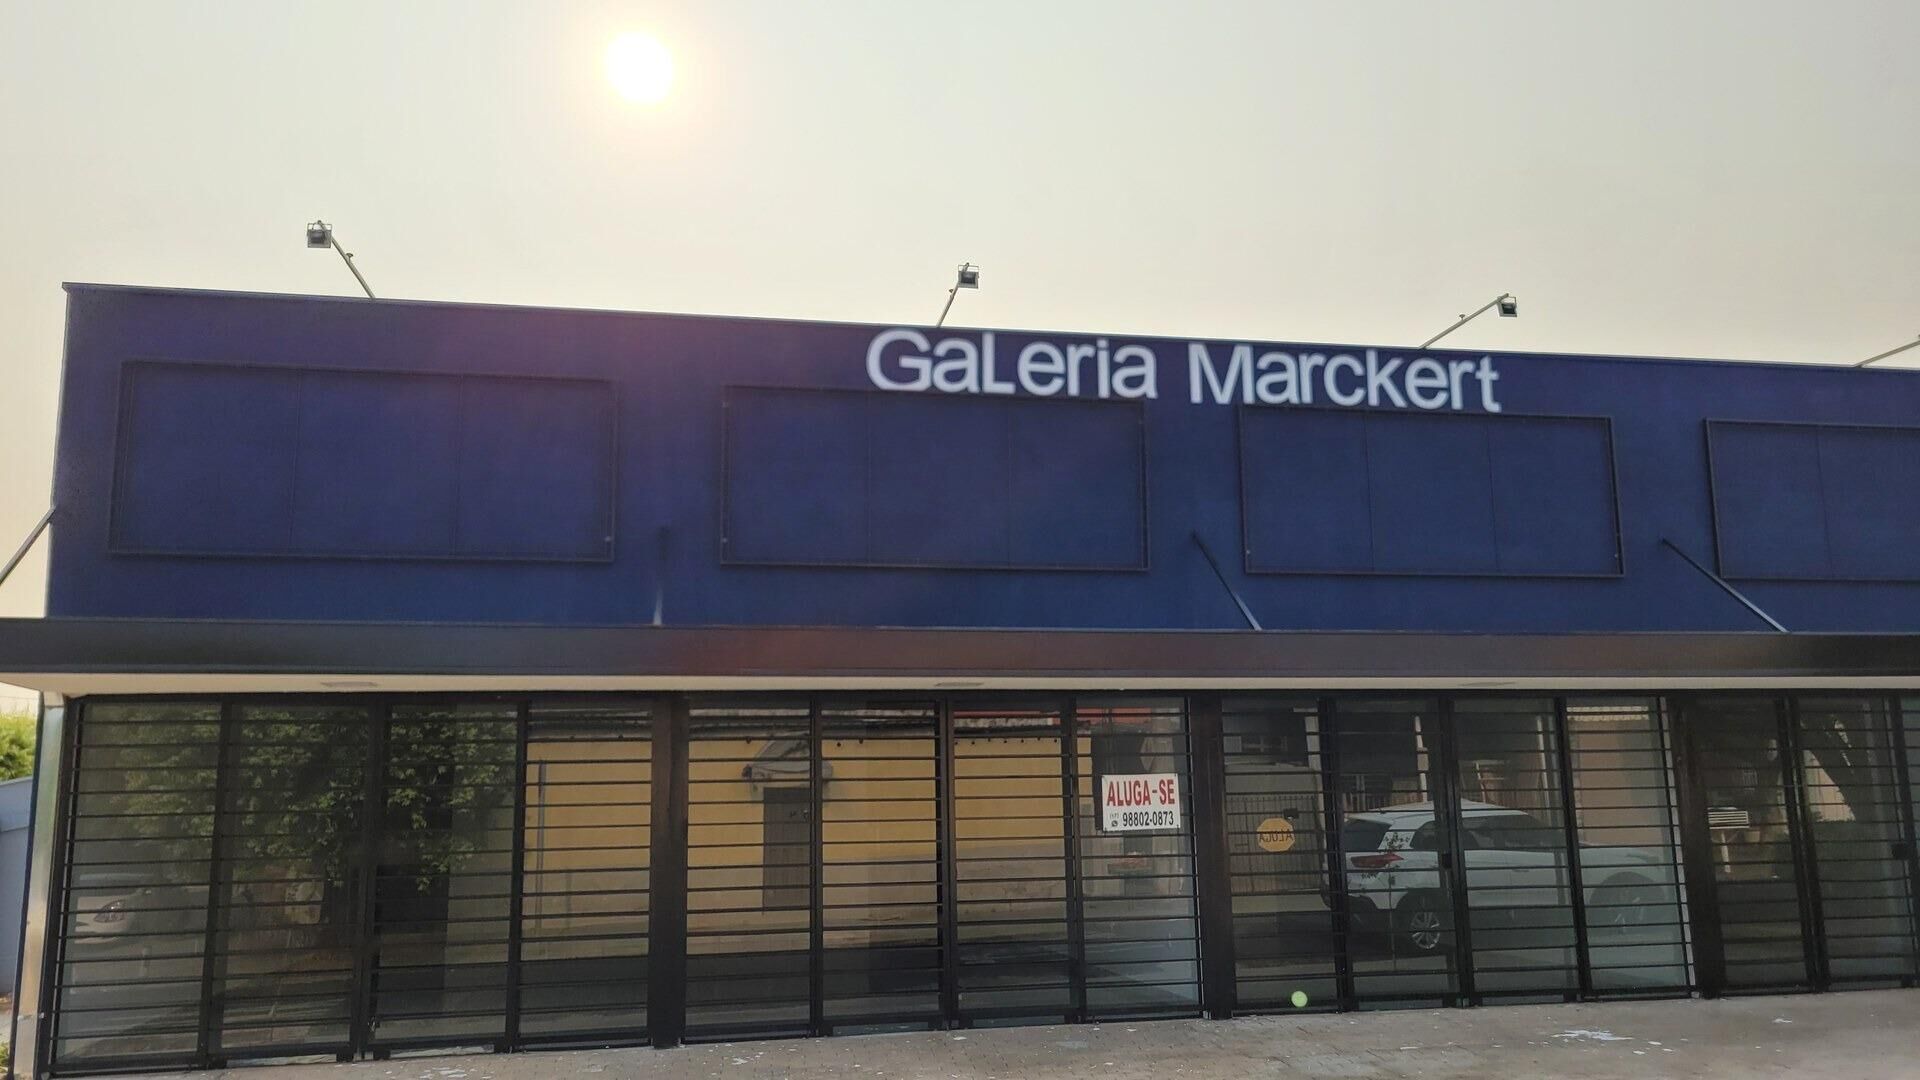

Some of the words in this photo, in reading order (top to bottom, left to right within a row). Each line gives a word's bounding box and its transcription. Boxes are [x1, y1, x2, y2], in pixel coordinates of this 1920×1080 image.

[867, 329, 1157, 399] GaLeria
[1188, 343, 1501, 411] Marckert
[1107, 779, 1175, 806] ALUGA-SE
[1122, 811, 1174, 826] 98802-0873
